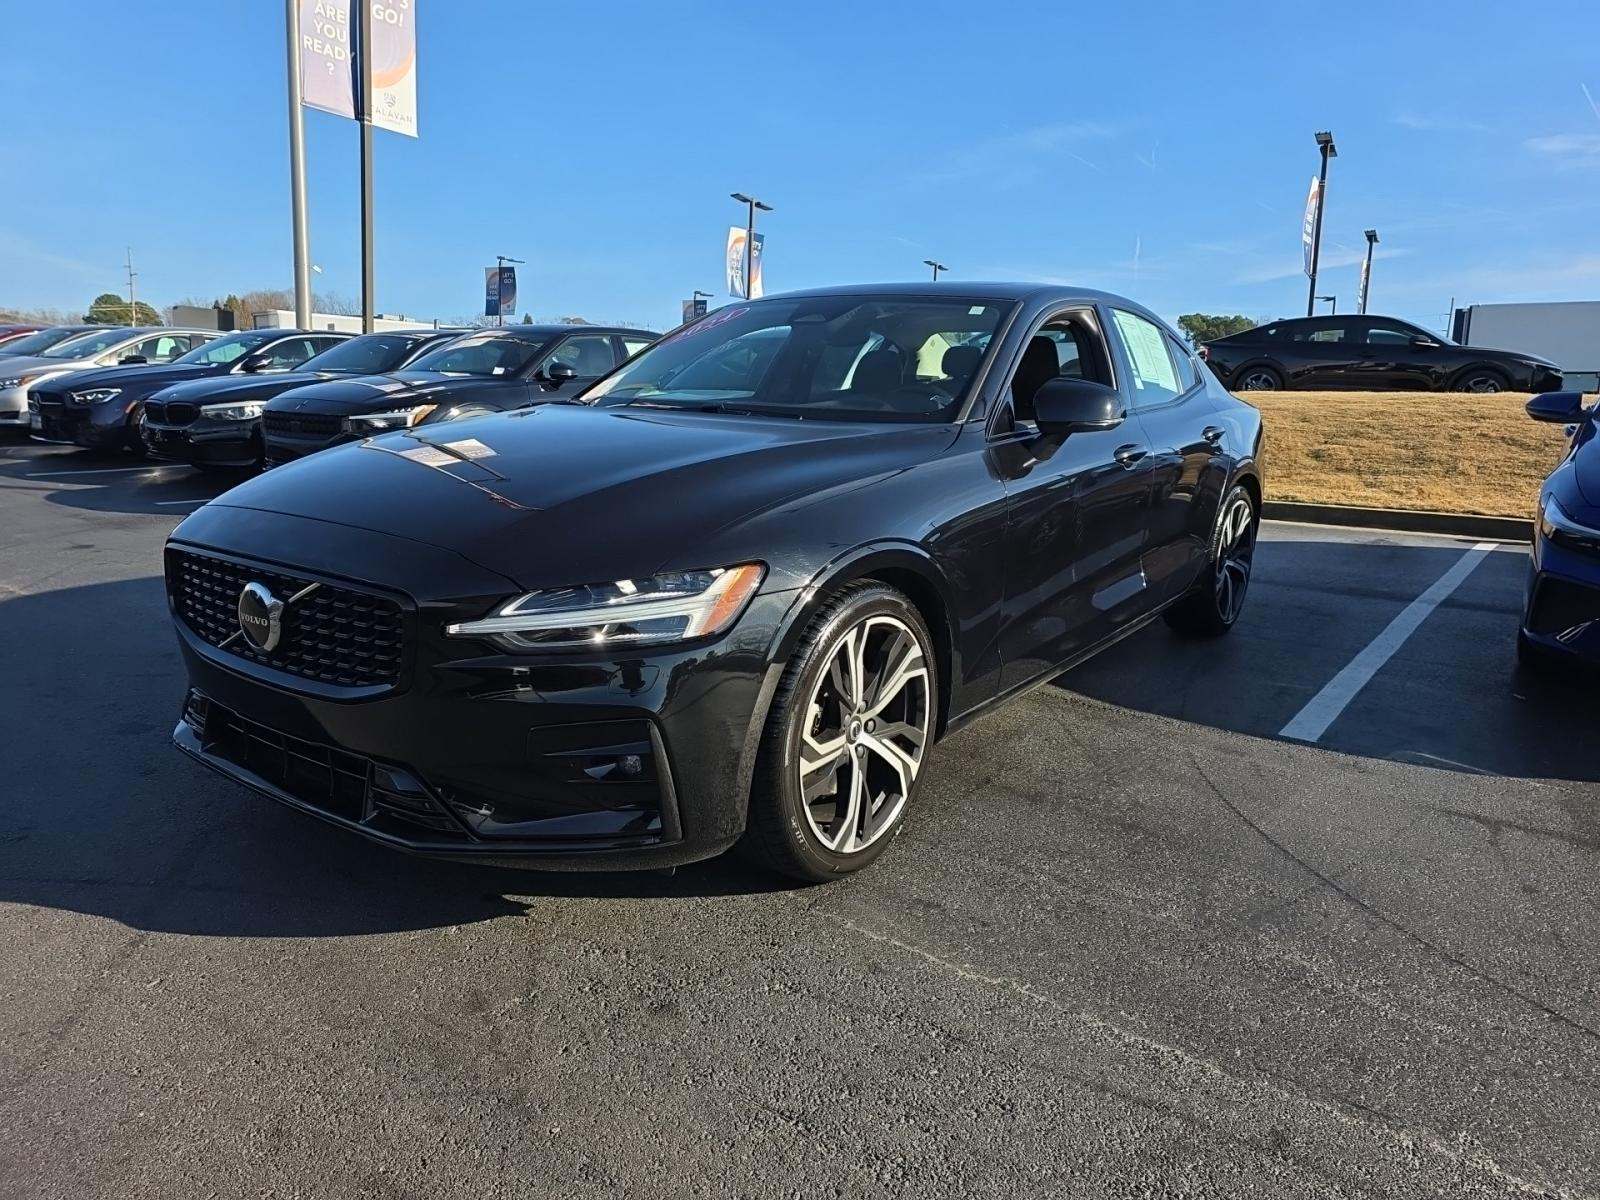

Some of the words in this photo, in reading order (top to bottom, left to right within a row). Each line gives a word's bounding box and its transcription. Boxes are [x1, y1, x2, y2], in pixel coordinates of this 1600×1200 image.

[314, 2, 346, 24] ARE
[372, 4, 403, 27] GO!
[313, 19, 347, 42] YOU
[241, 613, 268, 626] VOLVO
